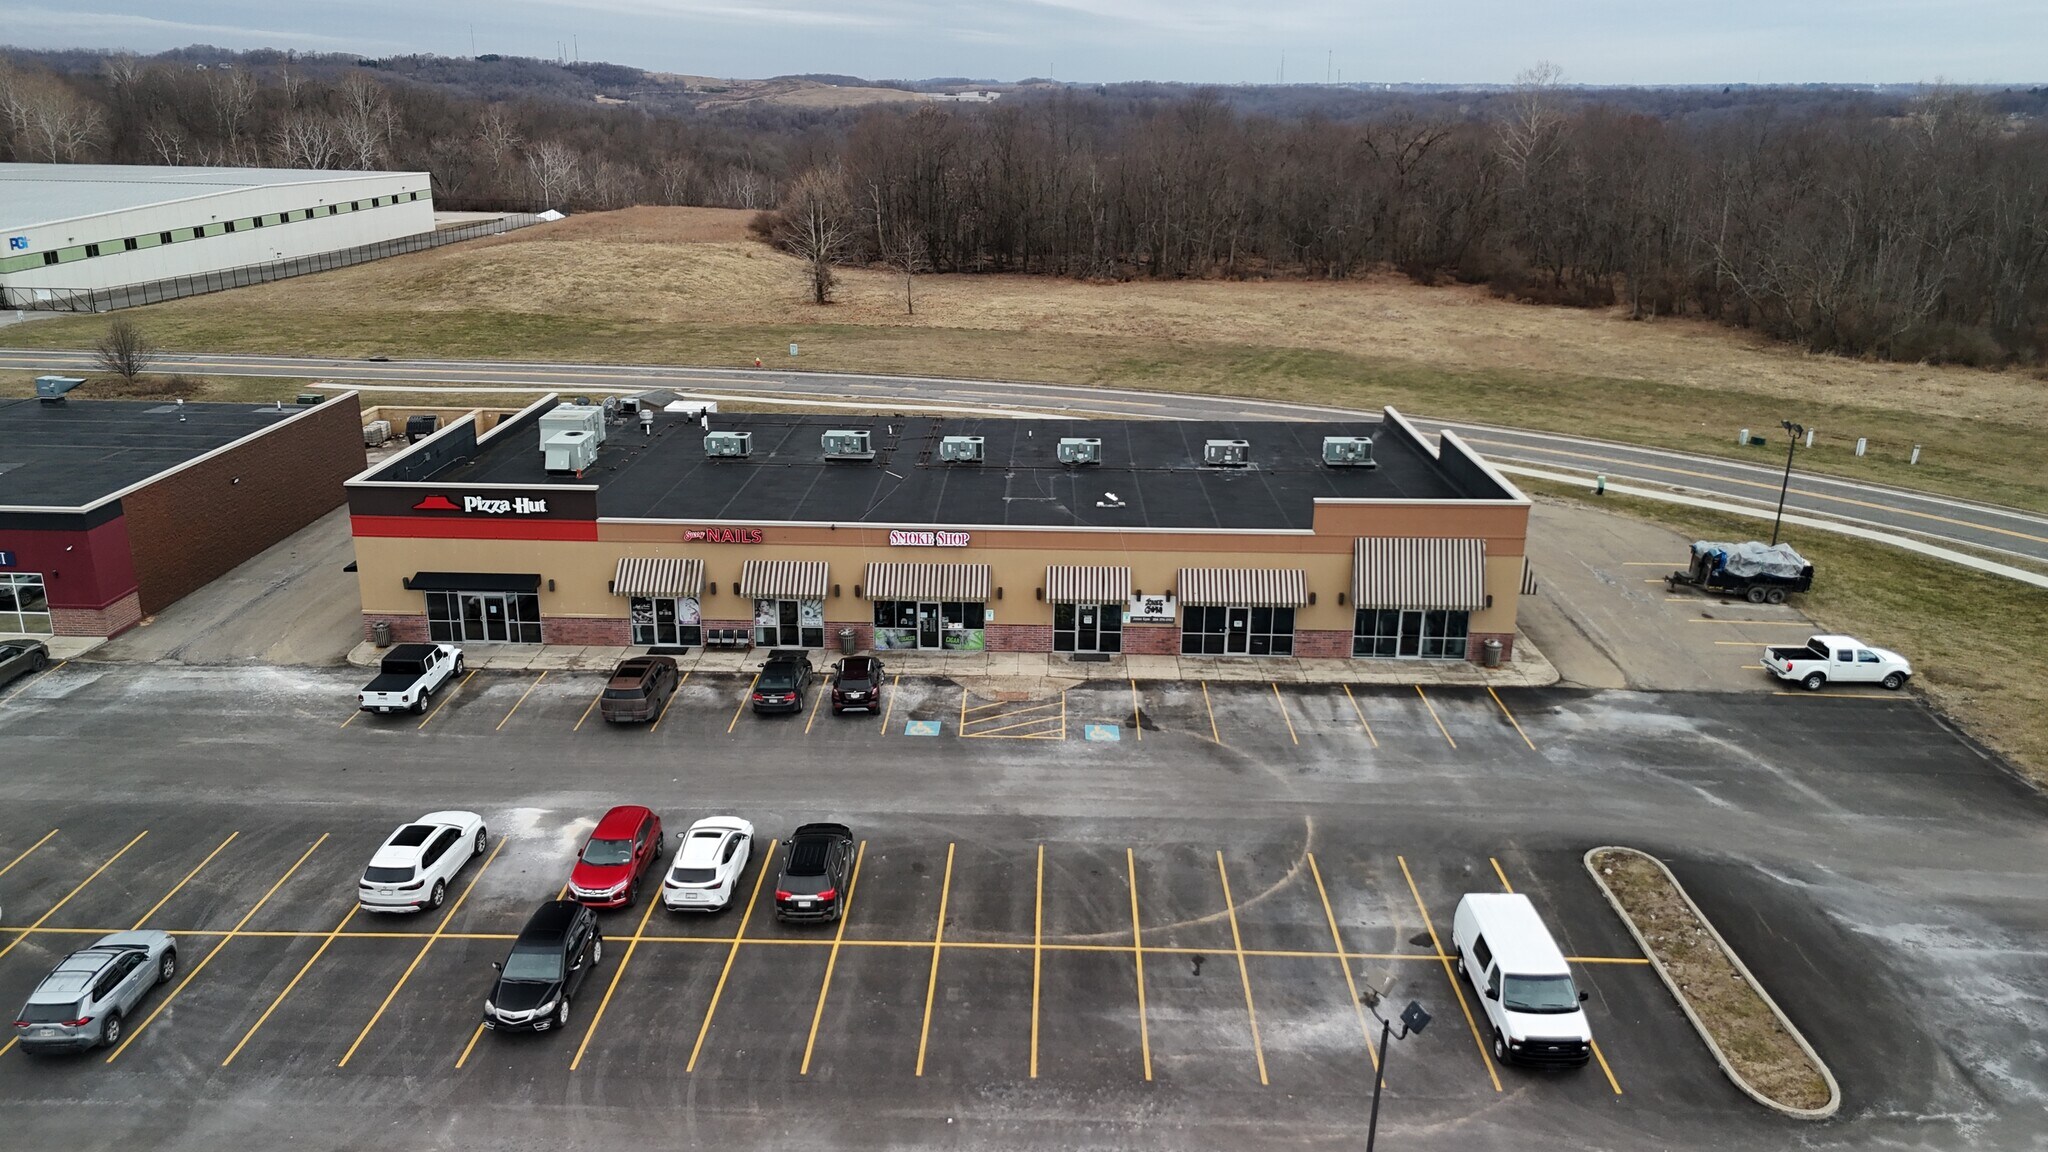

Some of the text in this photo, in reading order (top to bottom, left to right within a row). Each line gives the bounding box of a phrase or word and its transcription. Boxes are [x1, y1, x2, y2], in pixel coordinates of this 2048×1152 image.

[463, 496, 547, 514] Pizza Hut
[706, 528, 762, 543] NAILS
[890, 530, 969, 546] SMOKE SHOP
